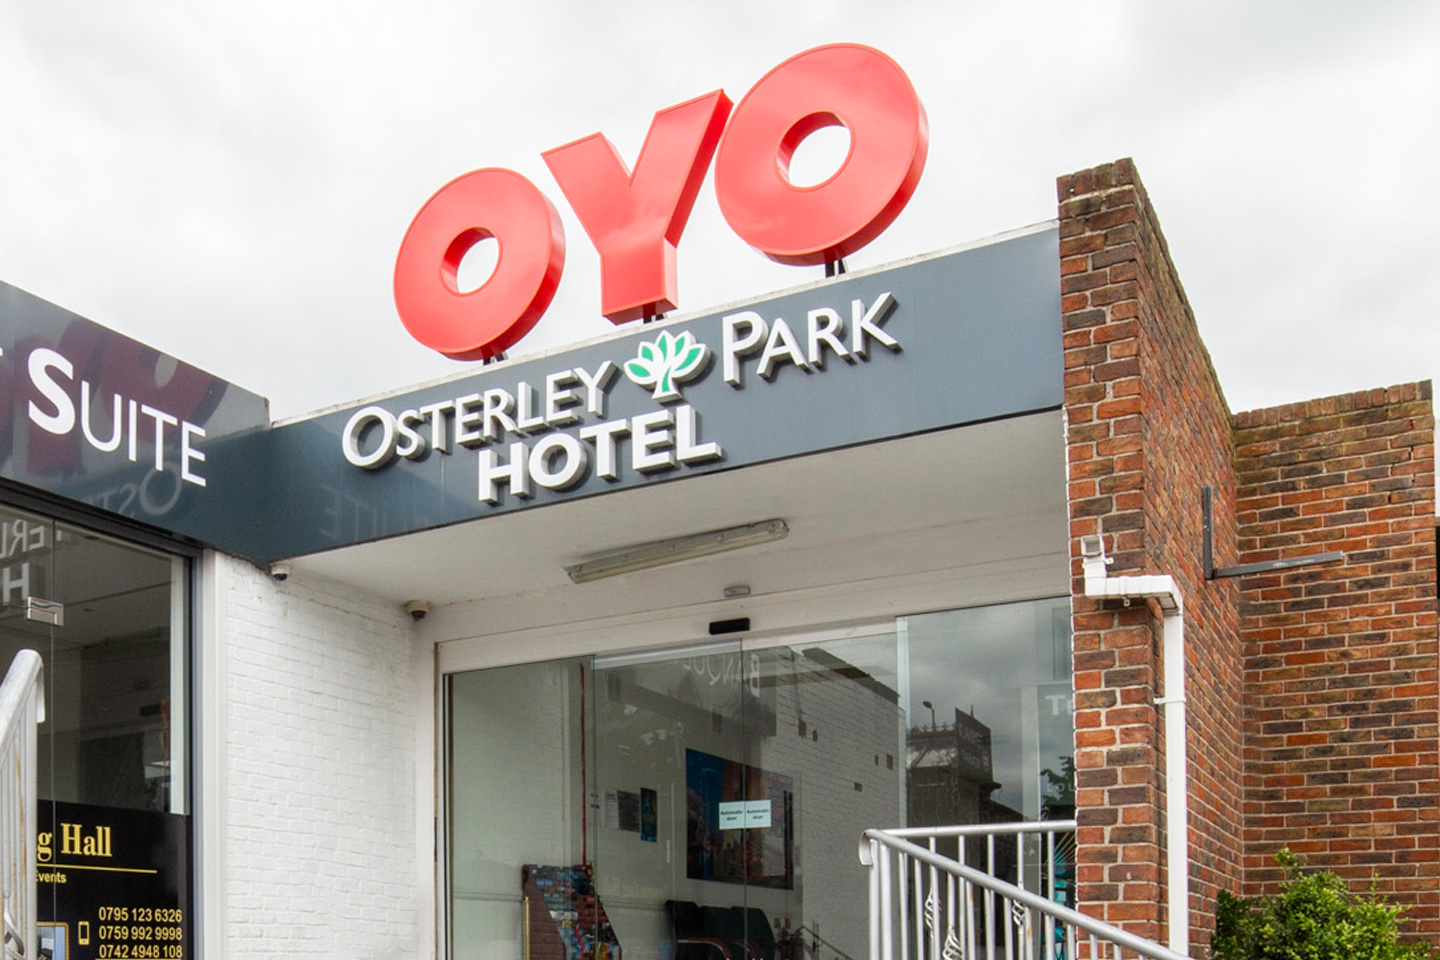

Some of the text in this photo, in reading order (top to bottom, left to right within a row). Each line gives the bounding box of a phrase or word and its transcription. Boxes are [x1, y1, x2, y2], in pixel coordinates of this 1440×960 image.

[393, 42, 930, 361] OYO
[341, 291, 904, 470] OSTERLEY PARK
[27, 346, 208, 487] SUITE
[477, 405, 724, 505] HOTEL
[60, 823, 113, 858] Hall
[98, 907, 183, 924] 0795 123 6326
[98, 925, 183, 941] 0759 992 9998
[99, 944, 183, 959] 0742 4948 108
